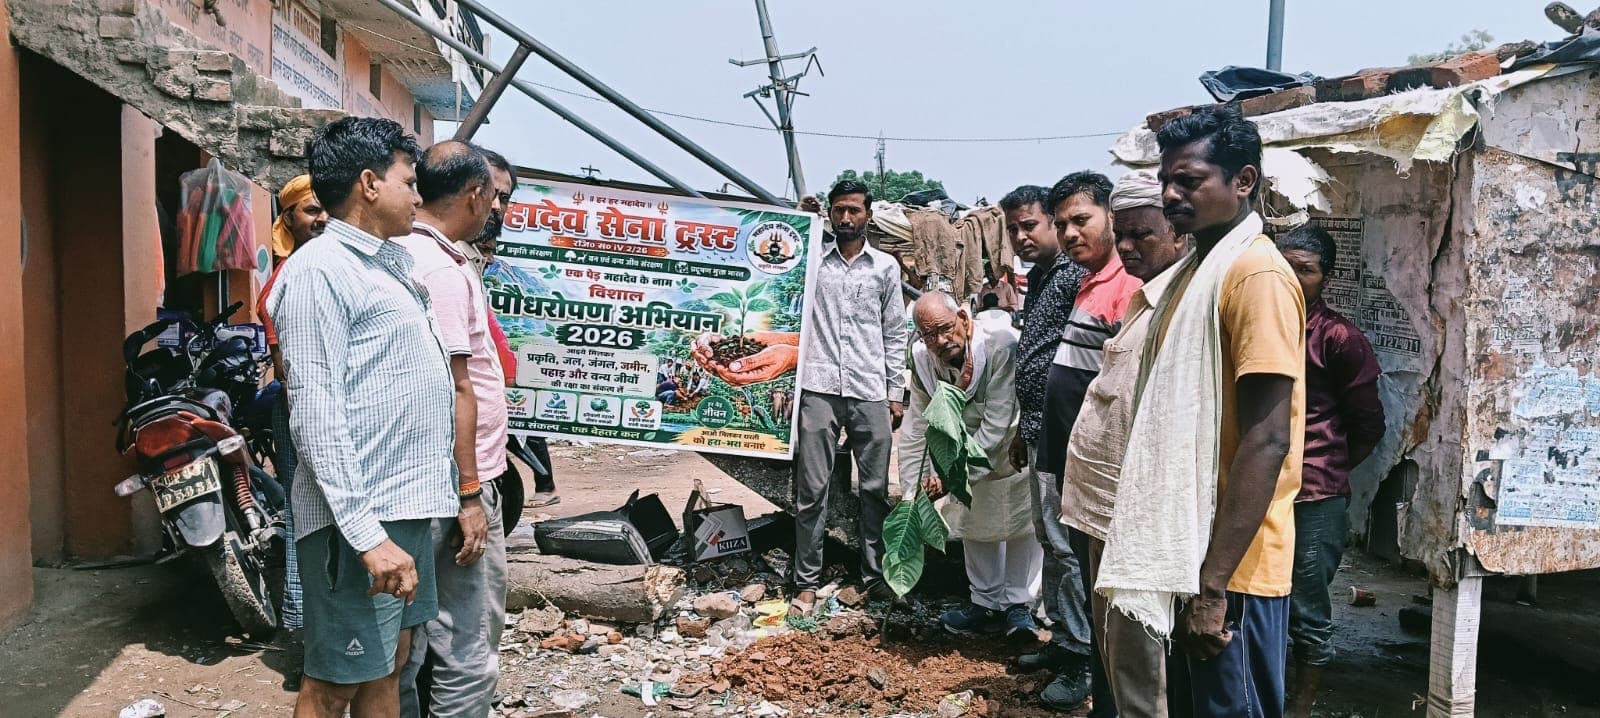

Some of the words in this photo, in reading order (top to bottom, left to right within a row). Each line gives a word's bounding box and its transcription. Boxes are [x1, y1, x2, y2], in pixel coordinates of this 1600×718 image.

[621, 200, 646, 208] महादेव
[504, 199, 588, 233] हादेव
[596, 207, 666, 241] सेना
[675, 220, 738, 250] ट्रस्ट
[529, 248, 552, 257] संरक्षण
[627, 246, 647, 254] 2/26
[640, 259, 662, 269] संरक्षण
[566, 268, 584, 278] एक
[586, 269, 600, 280] पेड़
[604, 272, 637, 284] महादेव
[640, 274, 649, 284] के
[652, 278, 672, 287] नाम
[588, 284, 644, 302] विशाल
[490, 284, 612, 322] पौधरोपण
[618, 301, 722, 333] अभियान
[567, 326, 633, 346] 2026
[527, 353, 559, 364] प्रकृति,
[562, 356, 584, 368] जल,
[588, 358, 618, 370] जंगल,
[620, 360, 650, 373] जमीन,
[540, 368, 566, 379] पहाड़
[569, 368, 588, 380] और
[590, 372, 610, 382] वन्य
[614, 372, 639, 384] जीवों
[702, 407, 727, 417] जीवन
[528, 420, 560, 432] संकल्प
[572, 425, 588, 433] एक
[591, 425, 618, 437] बेहतर
[621, 430, 640, 438] कल
[707, 438, 741, 448] हरा-भरा
